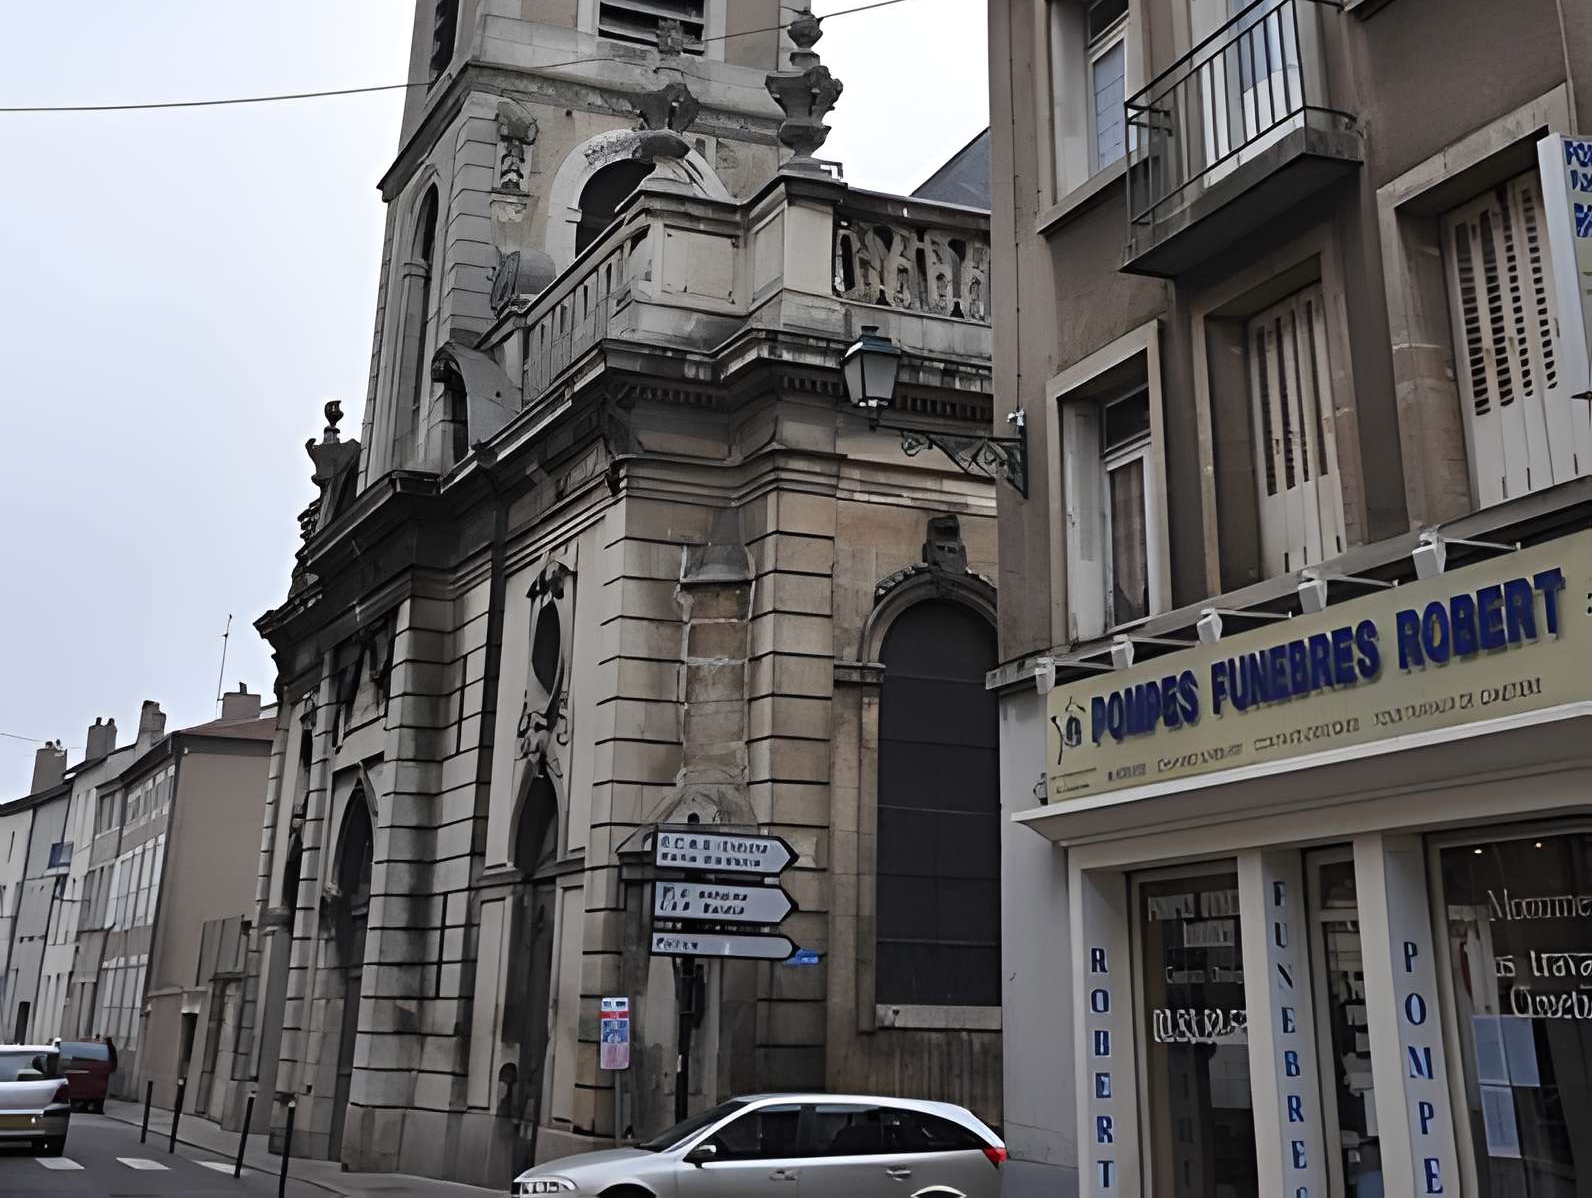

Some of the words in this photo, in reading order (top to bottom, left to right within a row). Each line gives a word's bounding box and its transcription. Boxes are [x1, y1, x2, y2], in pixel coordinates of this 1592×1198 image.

[1090, 669, 1200, 744] POMPES
[1210, 619, 1380, 715] FUNEBRES
[1396, 567, 1564, 671] ROBERT
